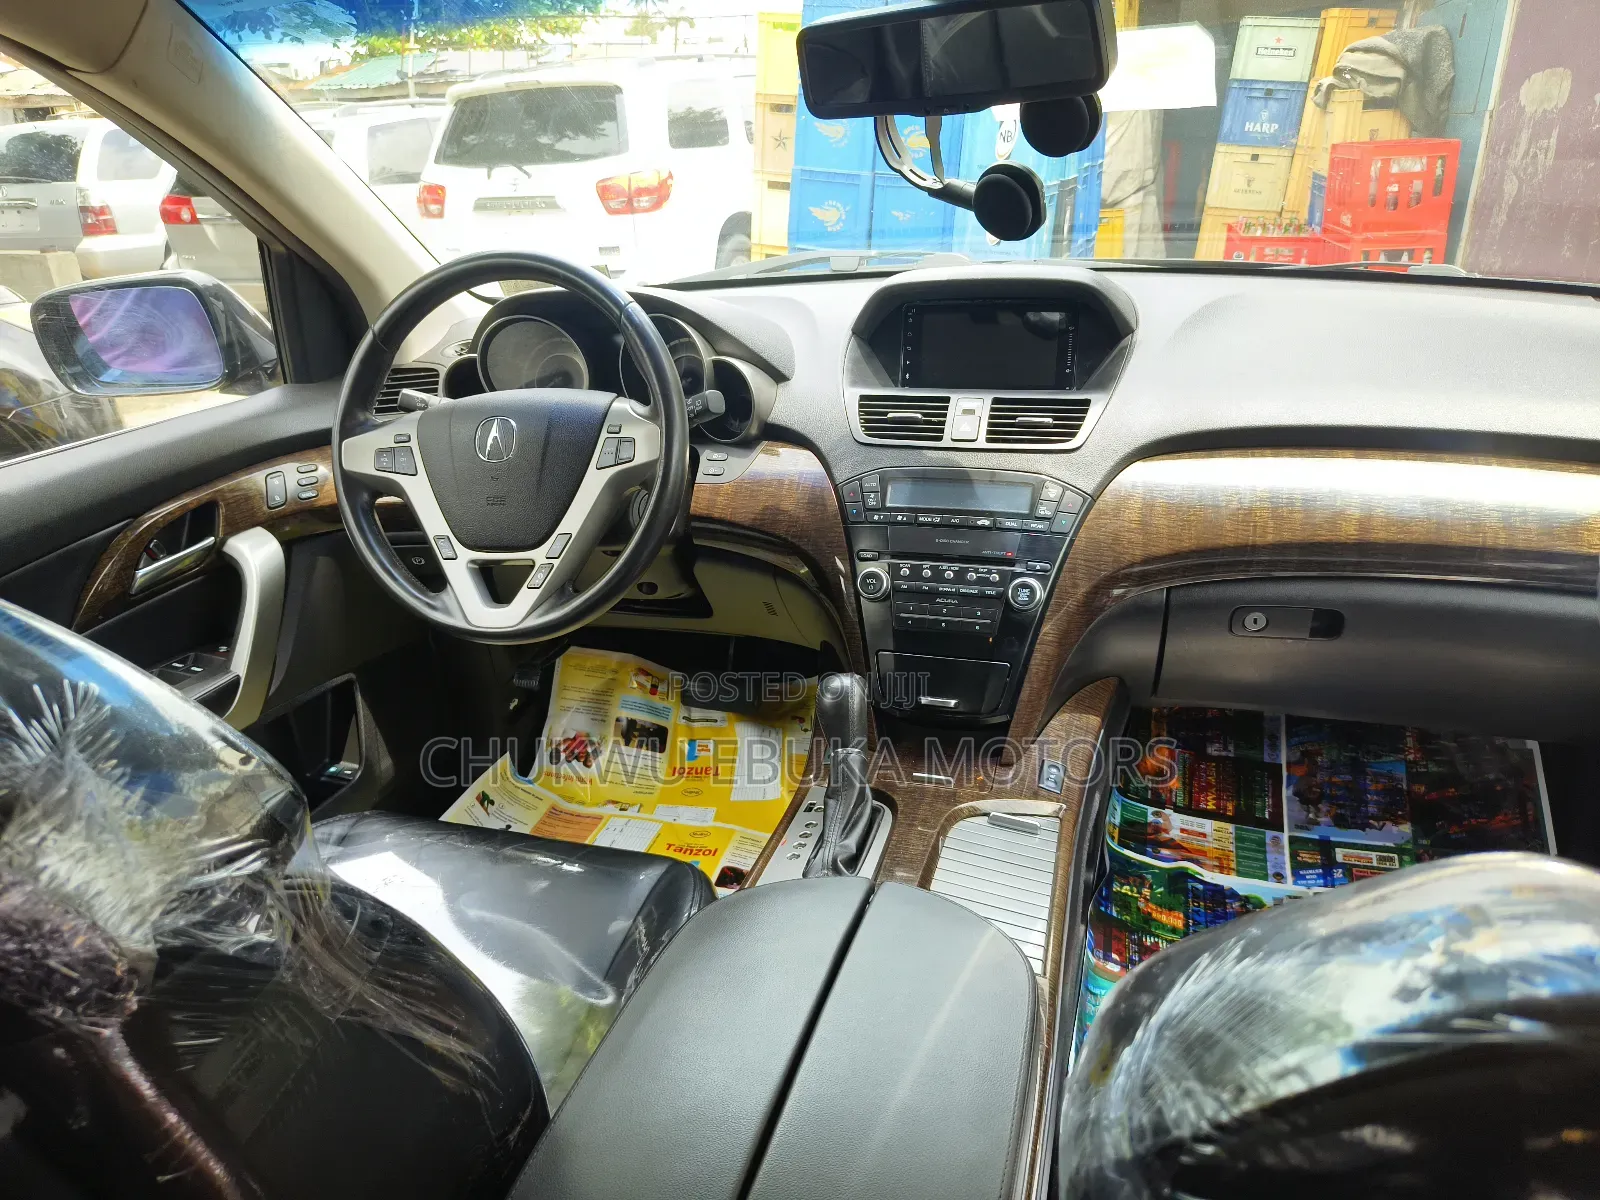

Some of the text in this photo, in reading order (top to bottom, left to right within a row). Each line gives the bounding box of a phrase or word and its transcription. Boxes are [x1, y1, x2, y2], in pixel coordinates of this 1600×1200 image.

[1258, 47, 1294, 56] Heineken
[1244, 121, 1279, 133] HARP
[672, 766, 720, 776] Tanzol
[1207, 787, 1216, 810] YAM
[665, 843, 718, 856] Tanzol
